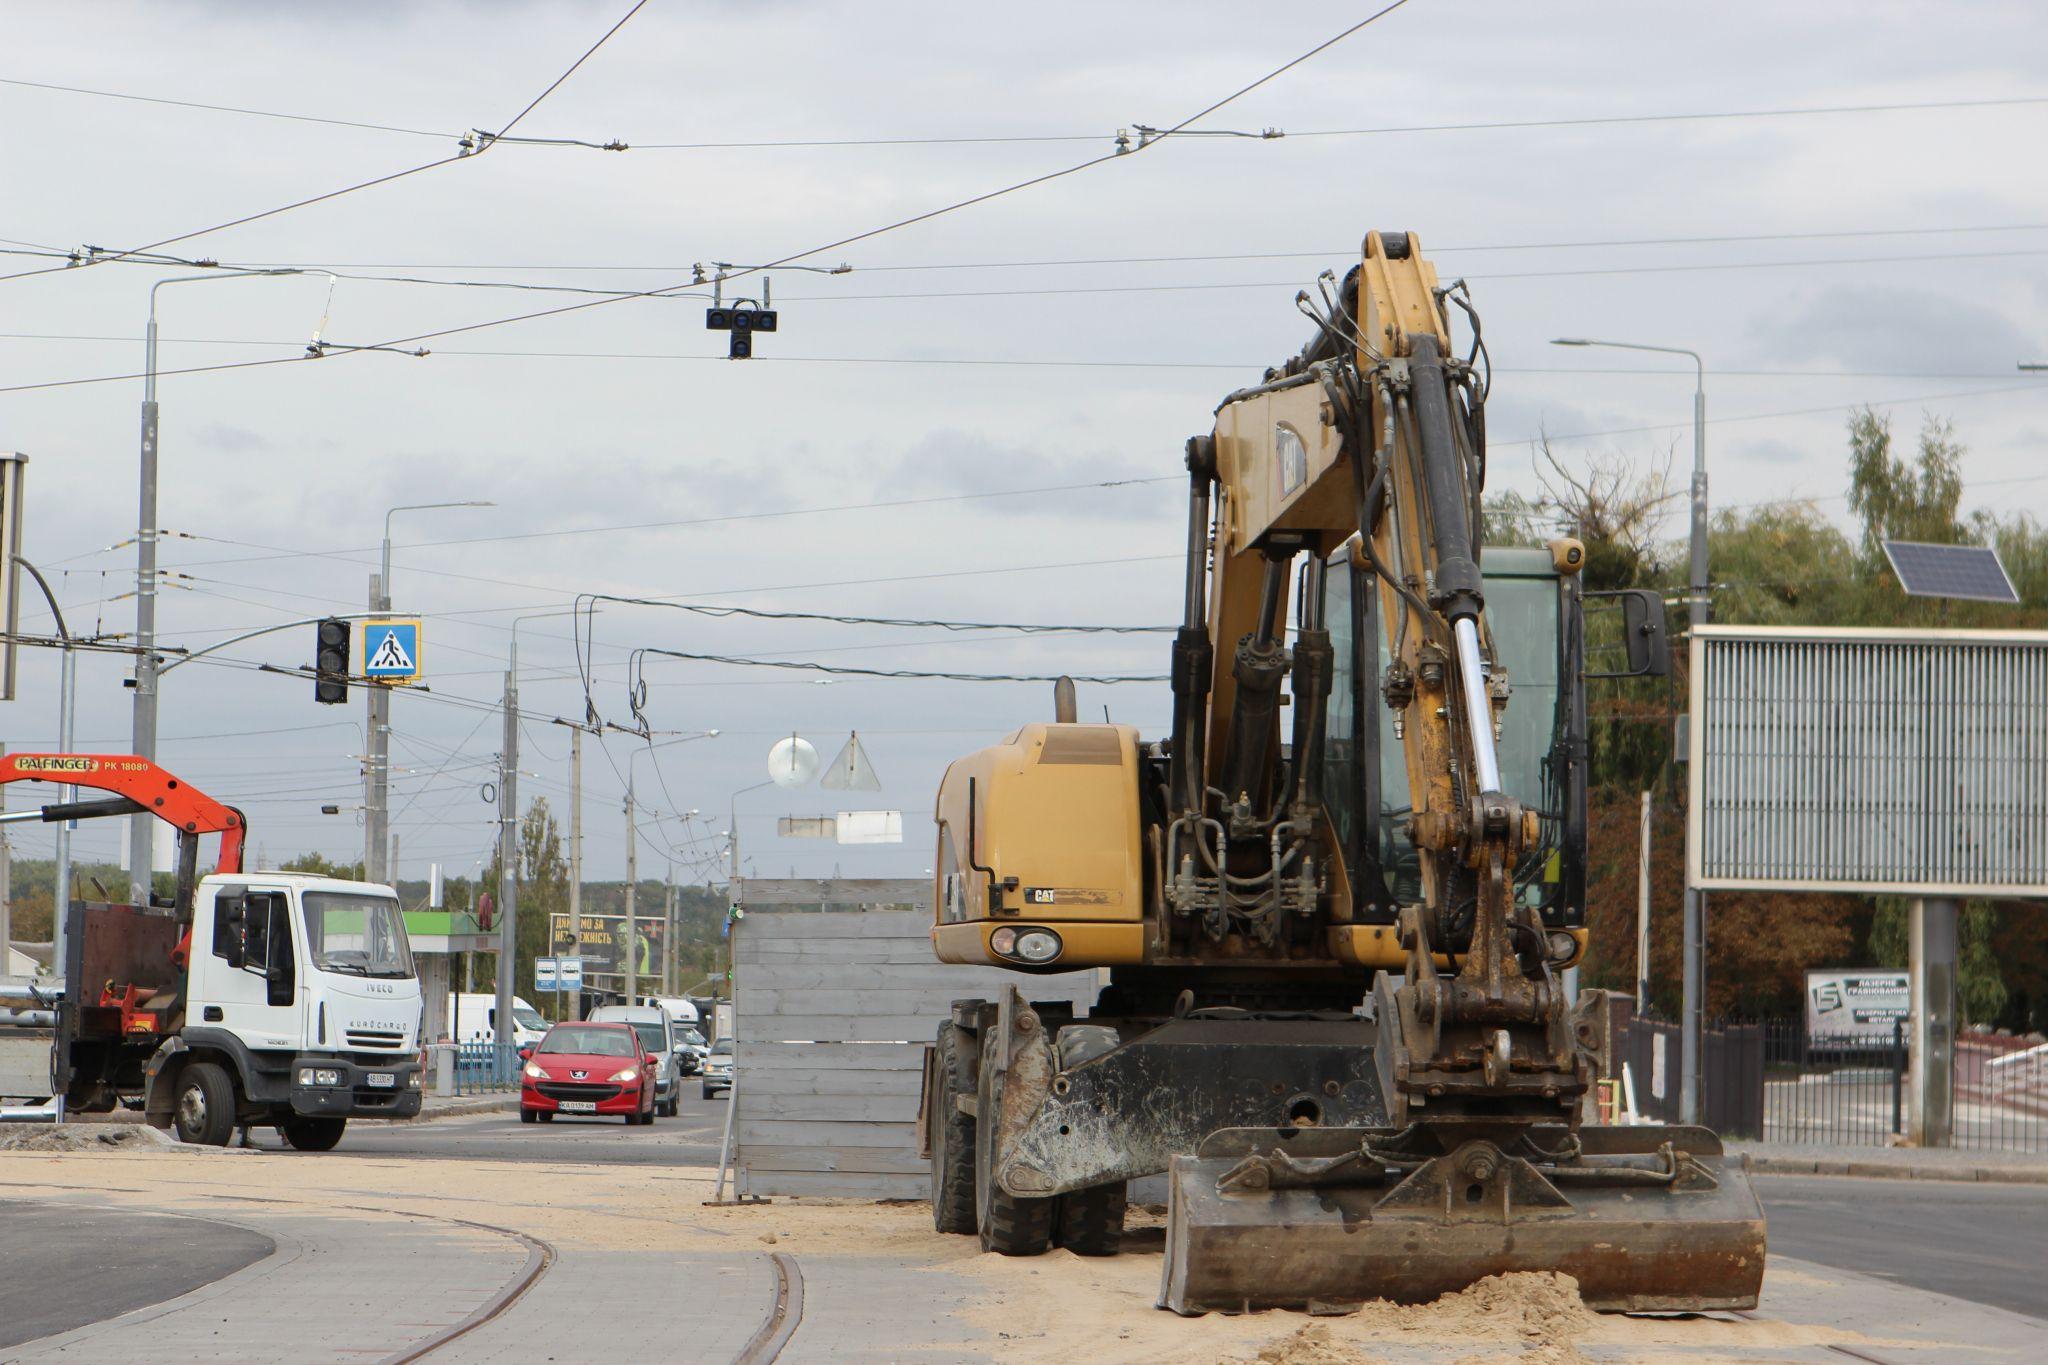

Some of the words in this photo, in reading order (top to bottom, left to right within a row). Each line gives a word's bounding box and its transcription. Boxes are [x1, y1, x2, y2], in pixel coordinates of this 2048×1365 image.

[104, 761, 117, 770] PK
[121, 762, 149, 771] 18080
[1034, 889, 1054, 902] CAT
[555, 930, 612, 944] НЕЗЕЖНІСТЬ
[366, 983, 393, 994] IVECO
